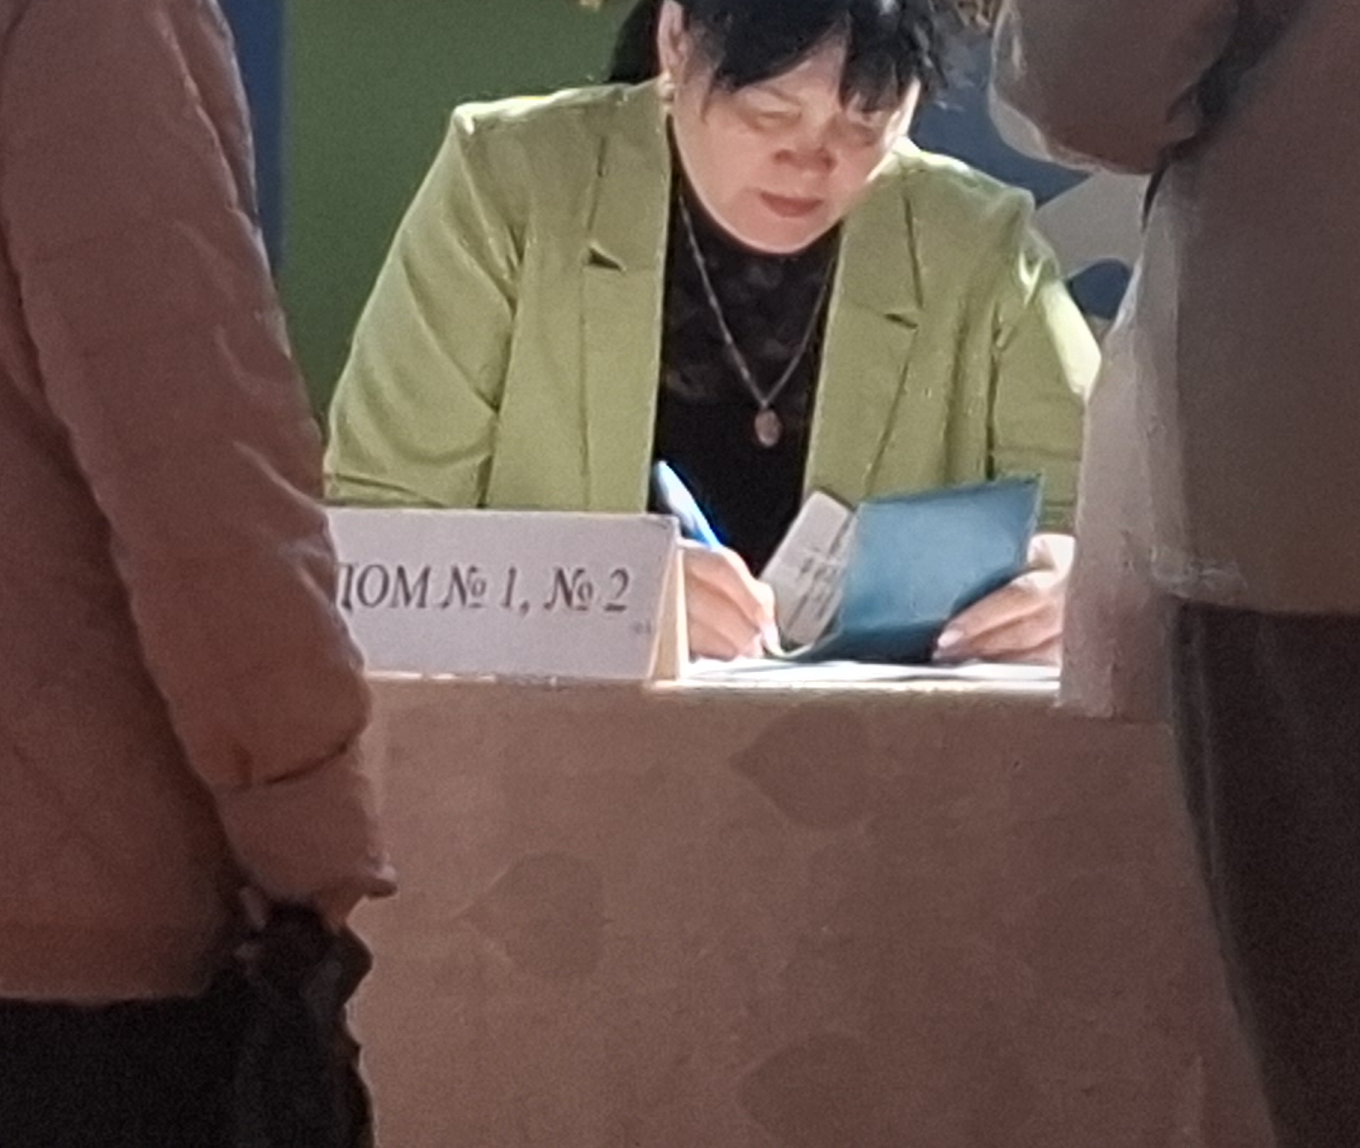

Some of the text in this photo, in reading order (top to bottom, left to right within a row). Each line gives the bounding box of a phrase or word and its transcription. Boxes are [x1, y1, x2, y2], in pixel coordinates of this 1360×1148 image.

[440, 564, 488, 610] №
[501, 565, 530, 617] 1,
[543, 566, 594, 612] №
[604, 567, 630, 613] 2
